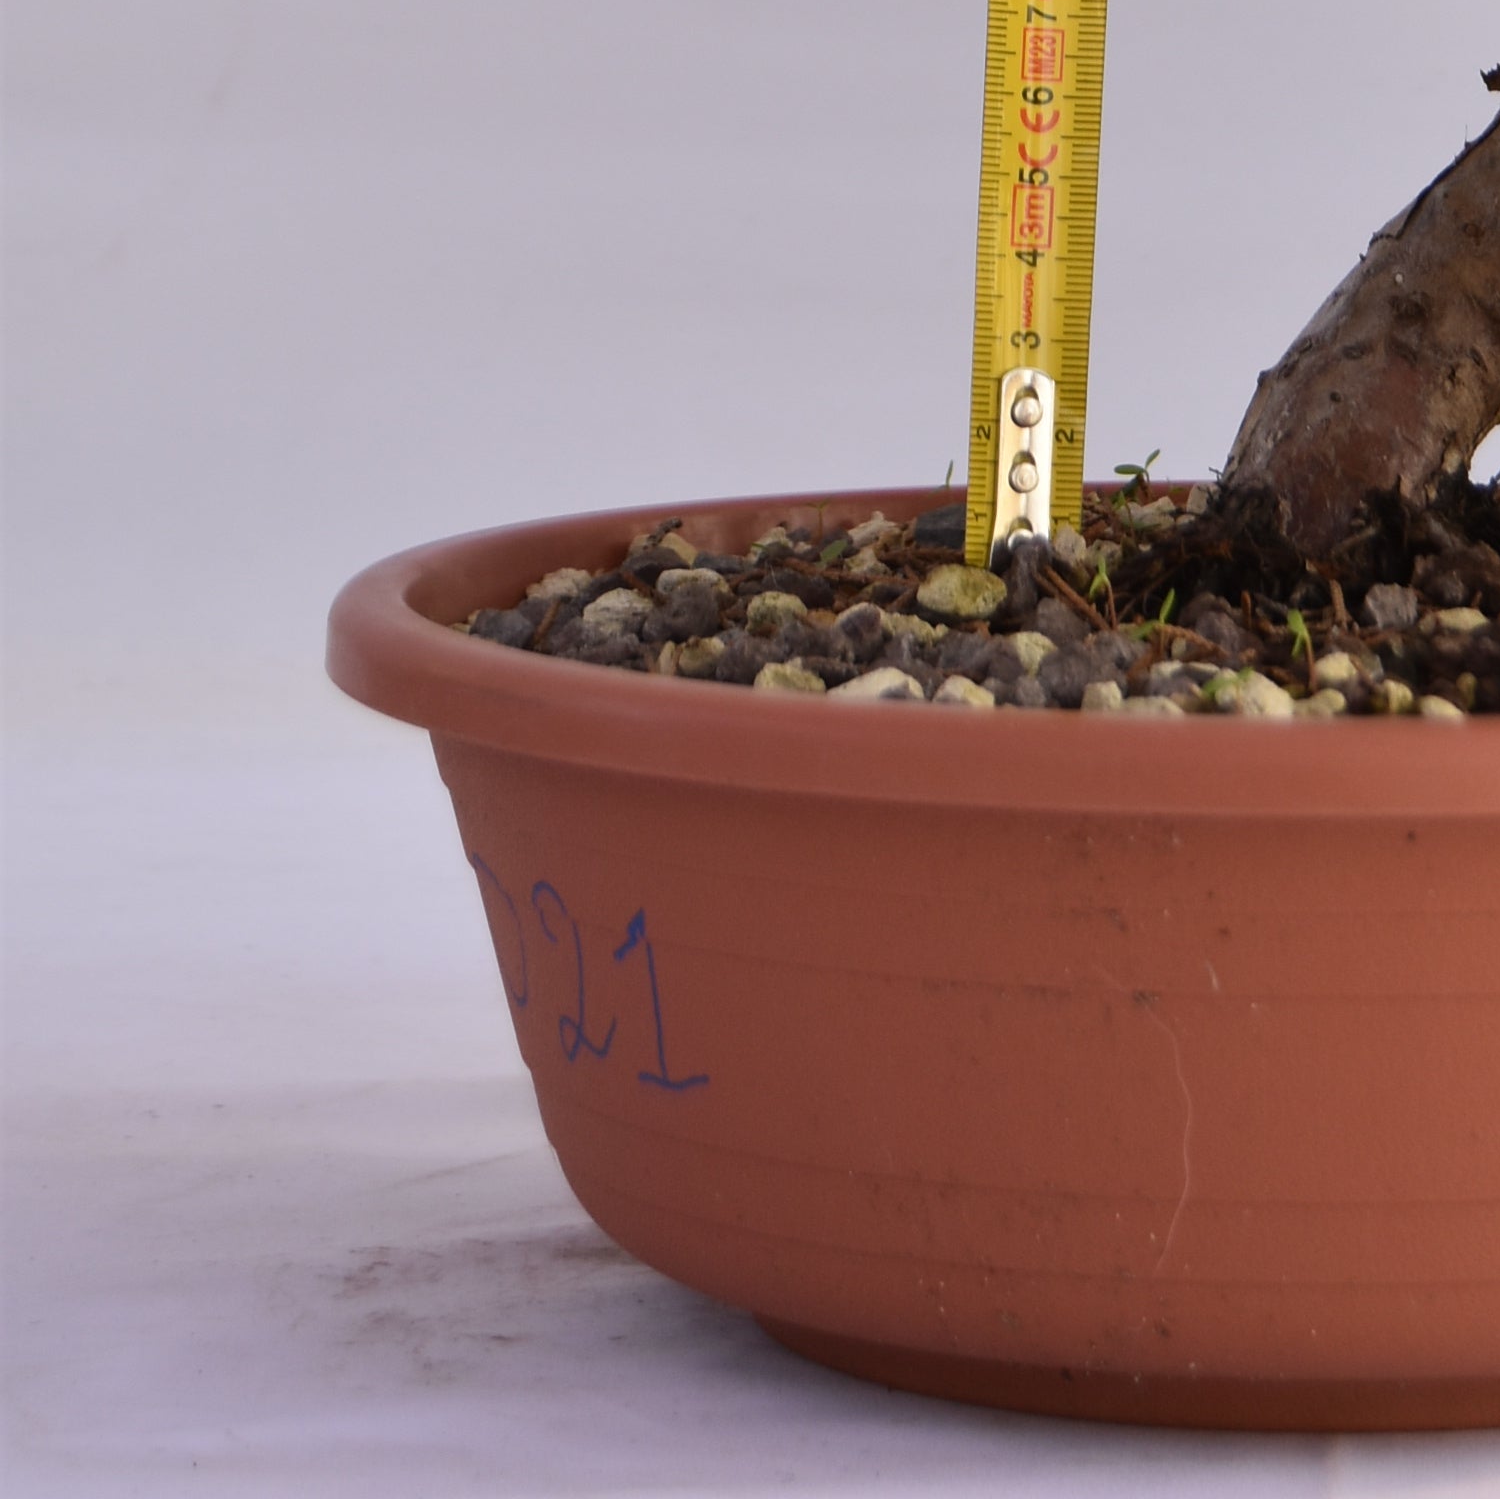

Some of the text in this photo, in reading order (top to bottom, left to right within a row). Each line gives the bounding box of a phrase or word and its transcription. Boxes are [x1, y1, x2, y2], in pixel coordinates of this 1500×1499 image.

[1027, 4, 1057, 23] 7
[1022, 86, 1054, 106] 6
[1018, 107, 1061, 169] CE
[1019, 166, 1049, 187] 5
[1018, 192, 1045, 240] 3m
[1015, 247, 1045, 268] 4
[1011, 329, 1041, 350] 3
[976, 425, 992, 441] 2
[1055, 428, 1076, 444] 2
